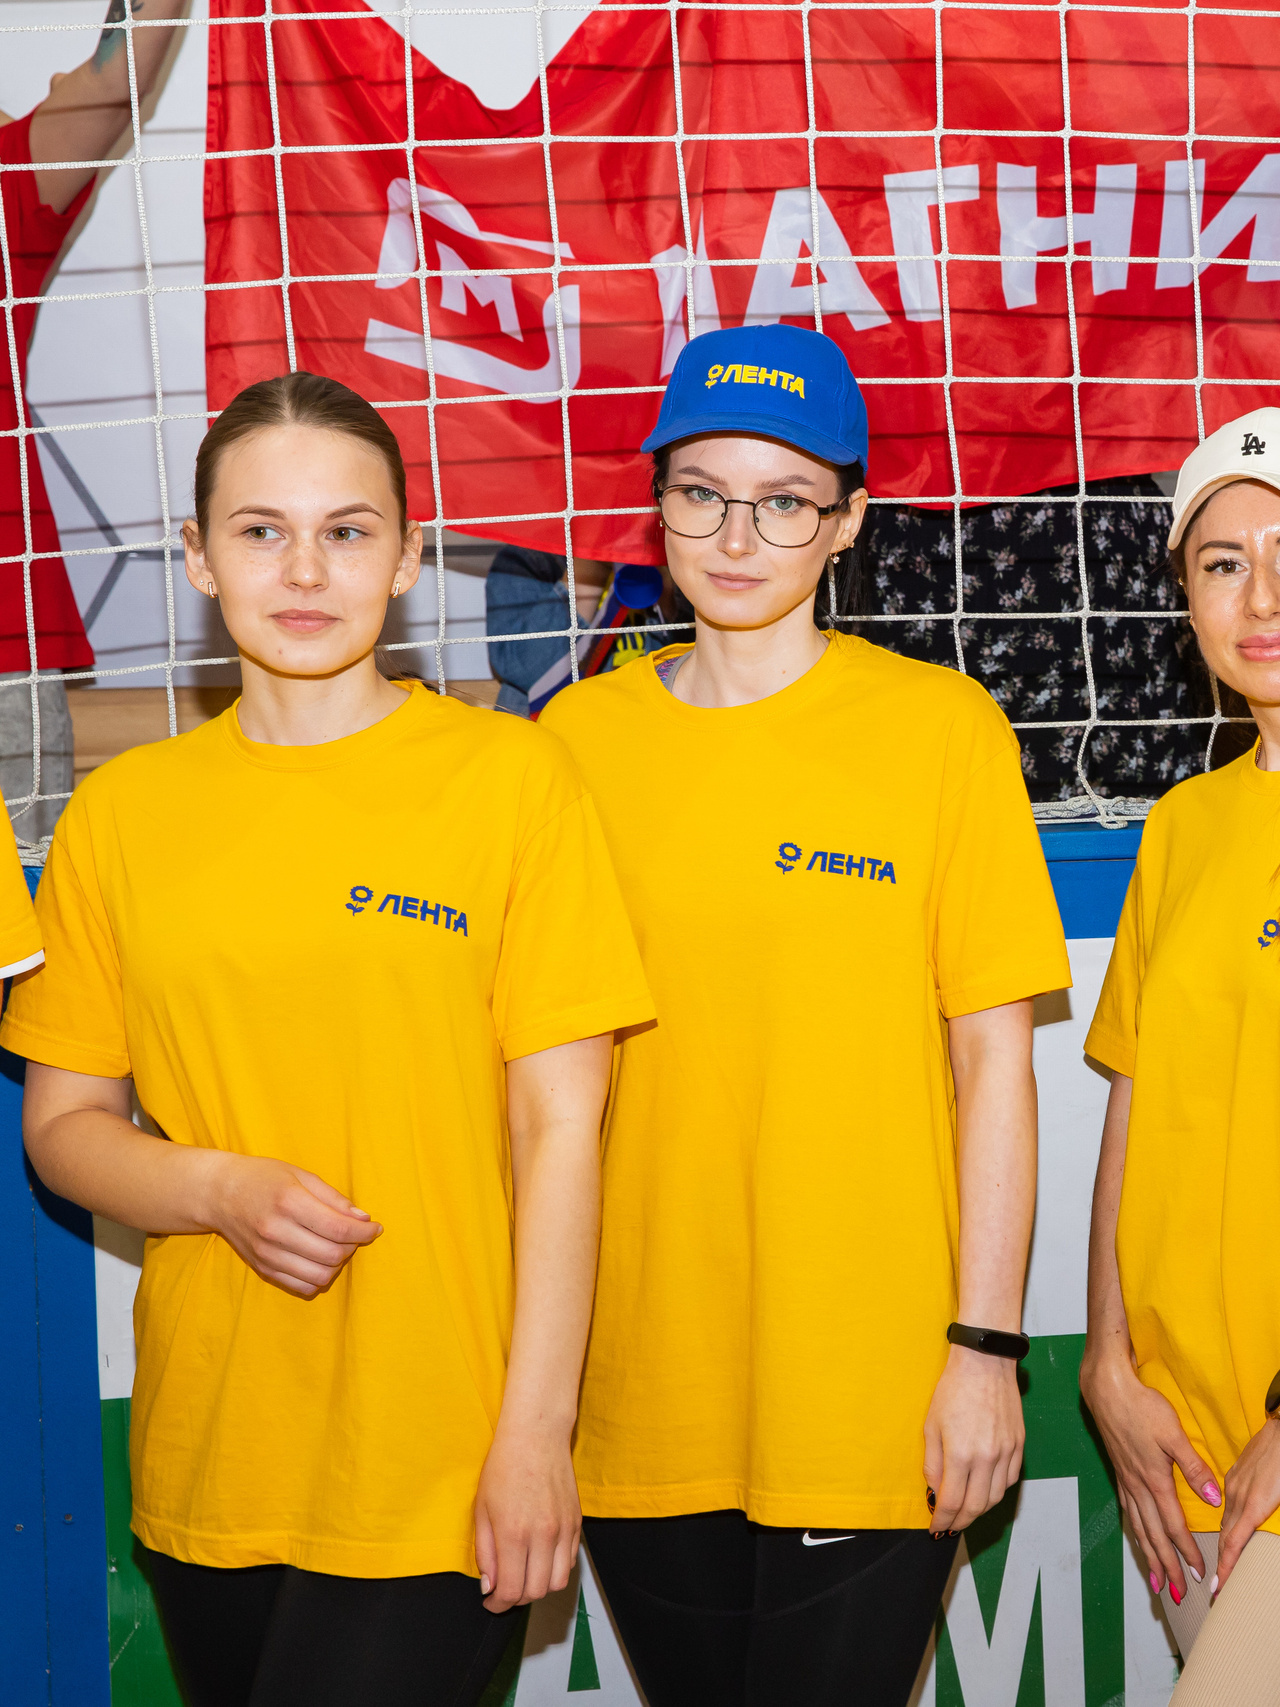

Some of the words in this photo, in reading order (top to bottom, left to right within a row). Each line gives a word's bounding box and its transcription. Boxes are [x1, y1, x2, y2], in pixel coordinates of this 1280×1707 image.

[720, 363, 806, 400] ЛЕНТА
[1240, 432, 1266, 457] LA
[805, 850, 897, 885] ЛЕНТА
[376, 892, 469, 938] ЛЕНТА
